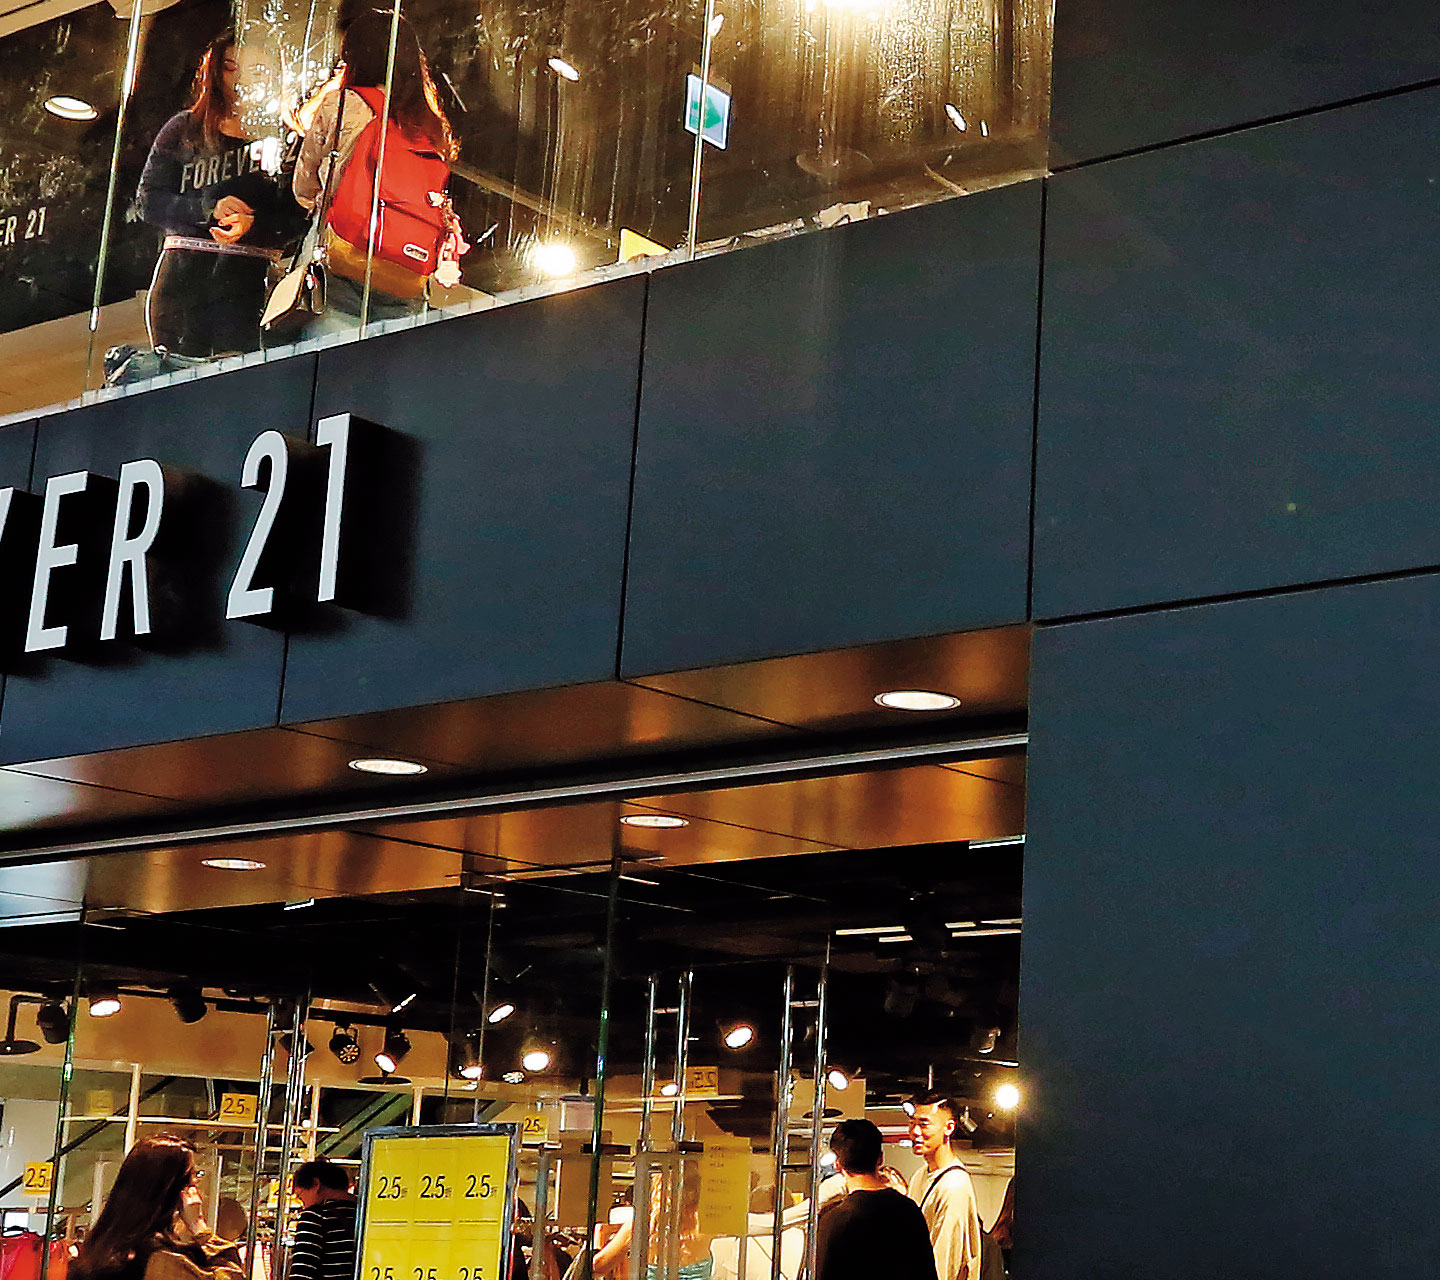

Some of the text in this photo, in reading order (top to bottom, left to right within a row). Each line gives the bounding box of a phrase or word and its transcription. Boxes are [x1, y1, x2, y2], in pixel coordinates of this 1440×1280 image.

[179, 139, 280, 194] FOREVE
[24, 206, 47, 239] 21
[225, 411, 351, 620] 21
